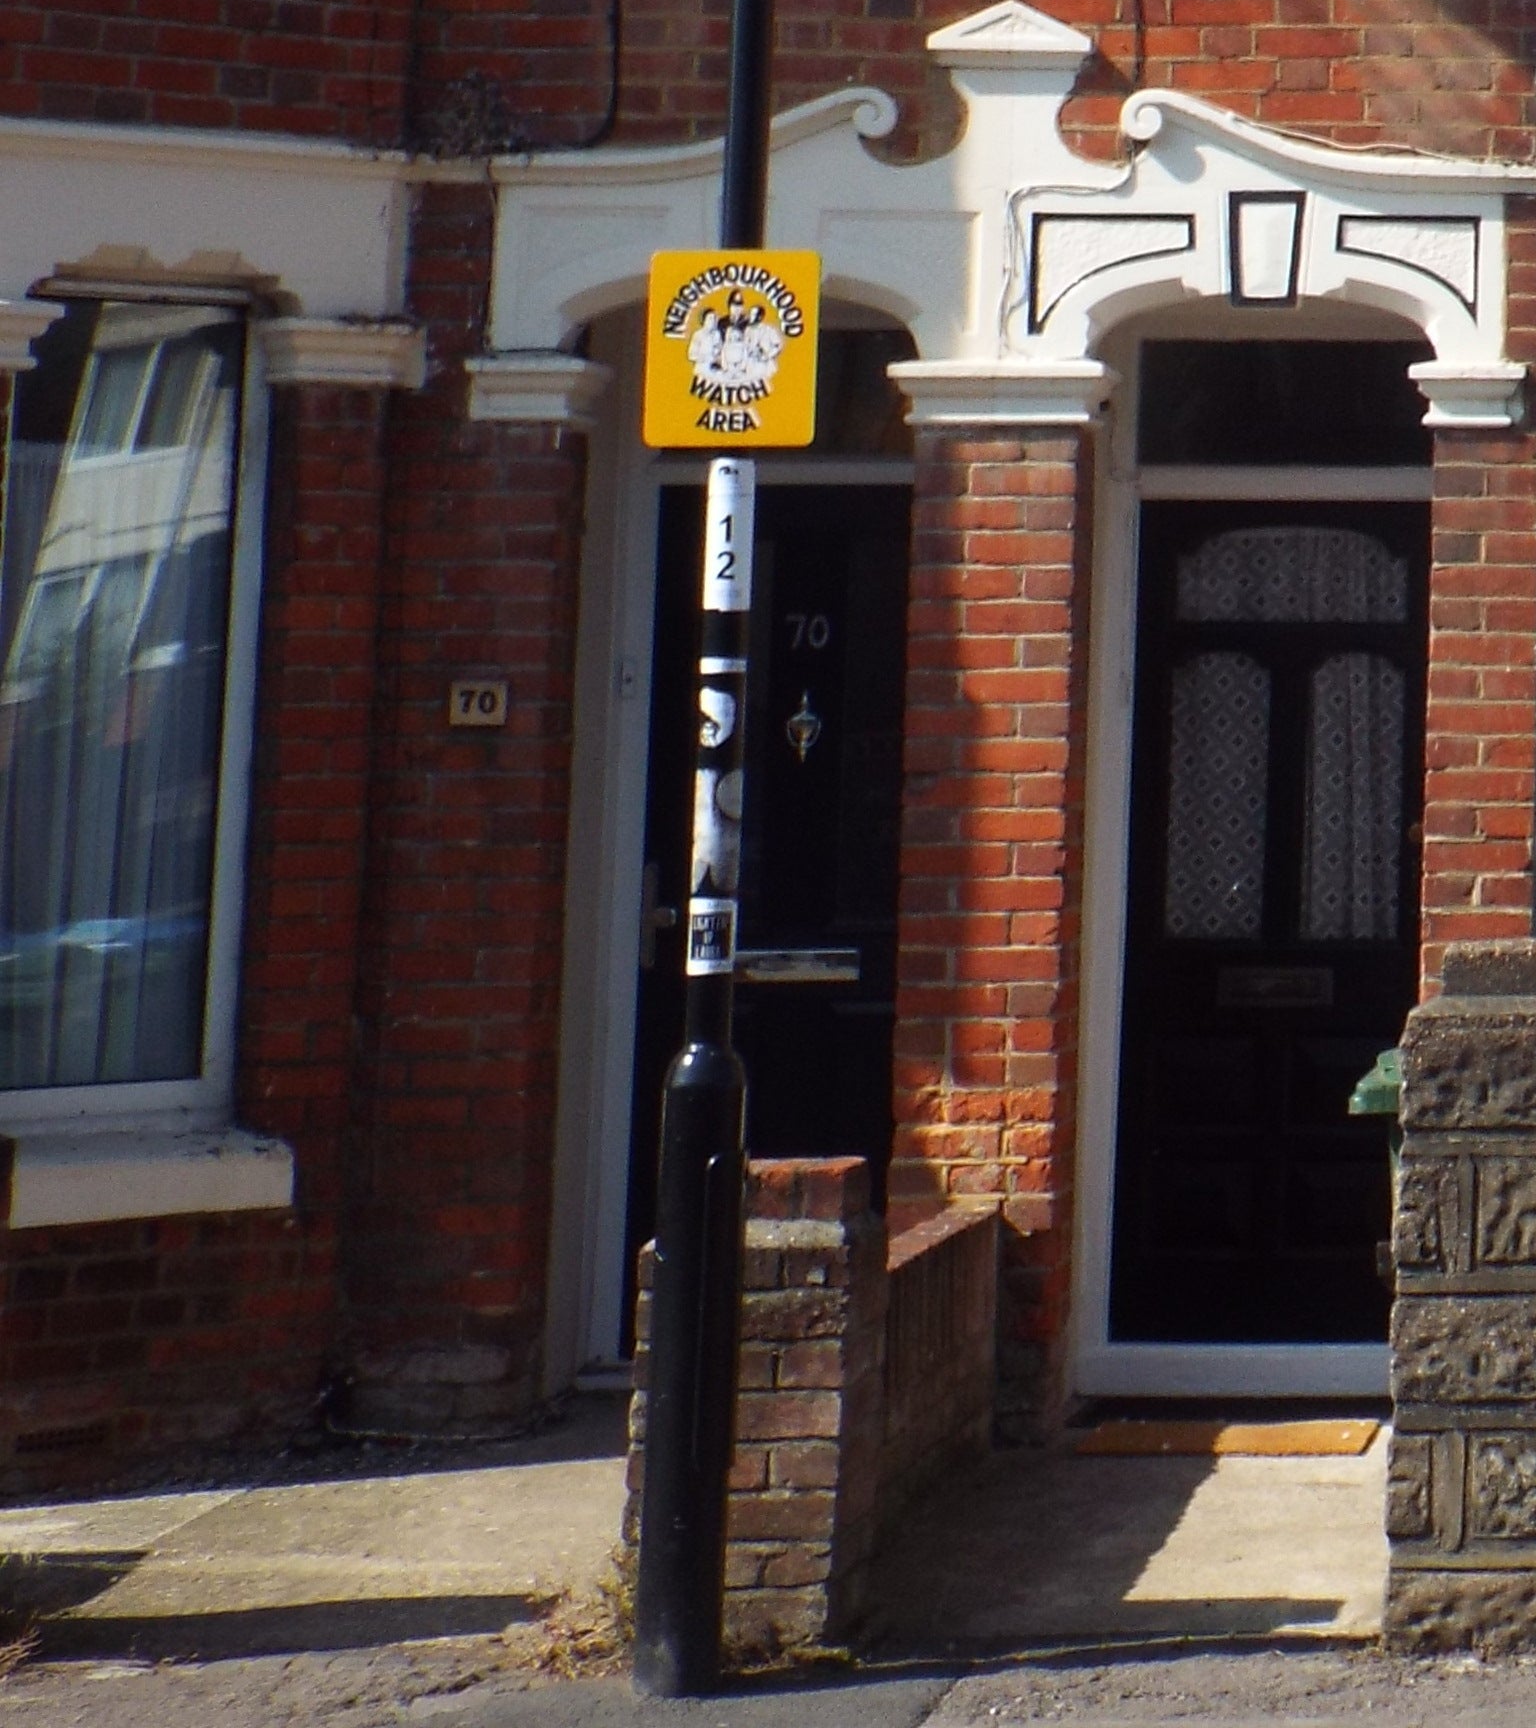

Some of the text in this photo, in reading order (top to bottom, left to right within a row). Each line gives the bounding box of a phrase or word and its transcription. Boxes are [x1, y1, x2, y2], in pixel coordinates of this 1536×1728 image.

[663, 263, 804, 338] NEIGHBOURHOOD
[690, 375, 769, 406] WATCH
[696, 409, 758, 432] AREA
[785, 614, 830, 650] 70
[460, 690, 497, 714] 70
